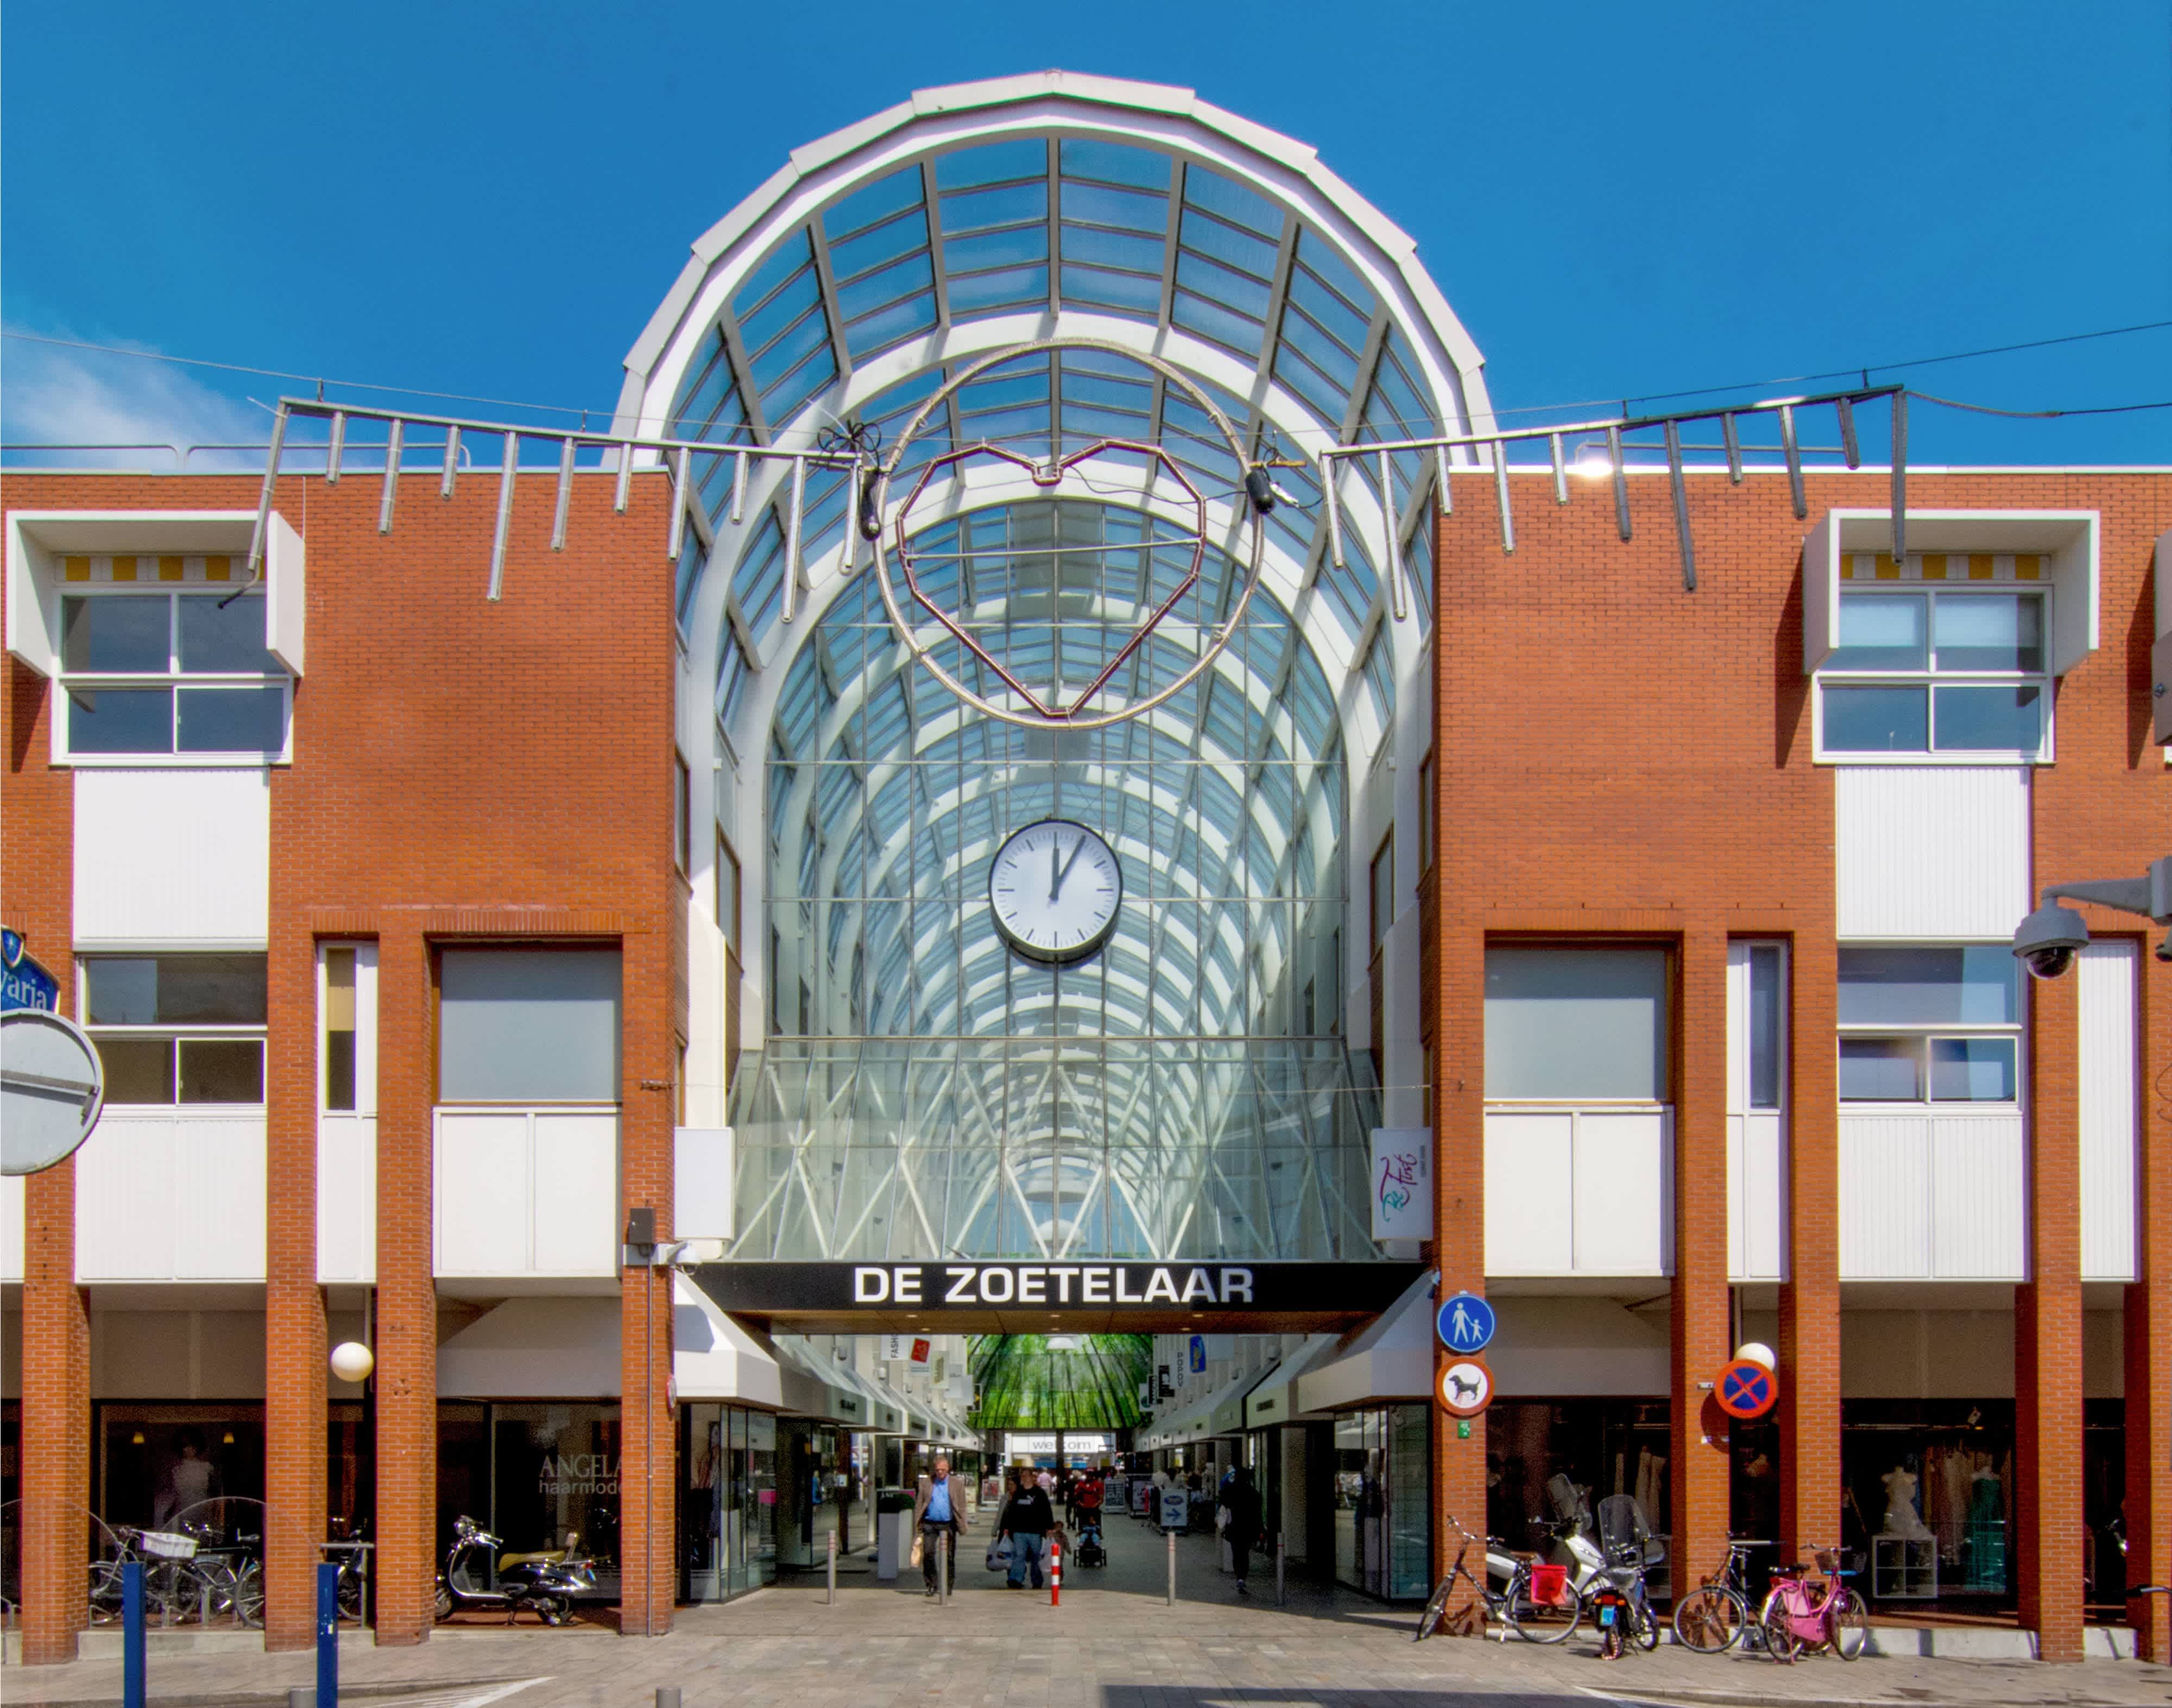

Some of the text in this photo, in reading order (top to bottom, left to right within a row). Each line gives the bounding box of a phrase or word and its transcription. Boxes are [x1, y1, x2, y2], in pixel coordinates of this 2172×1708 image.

[854, 1267, 1253, 1302] DE ZOETELAAR
[1033, 1440, 1091, 1449] weom
